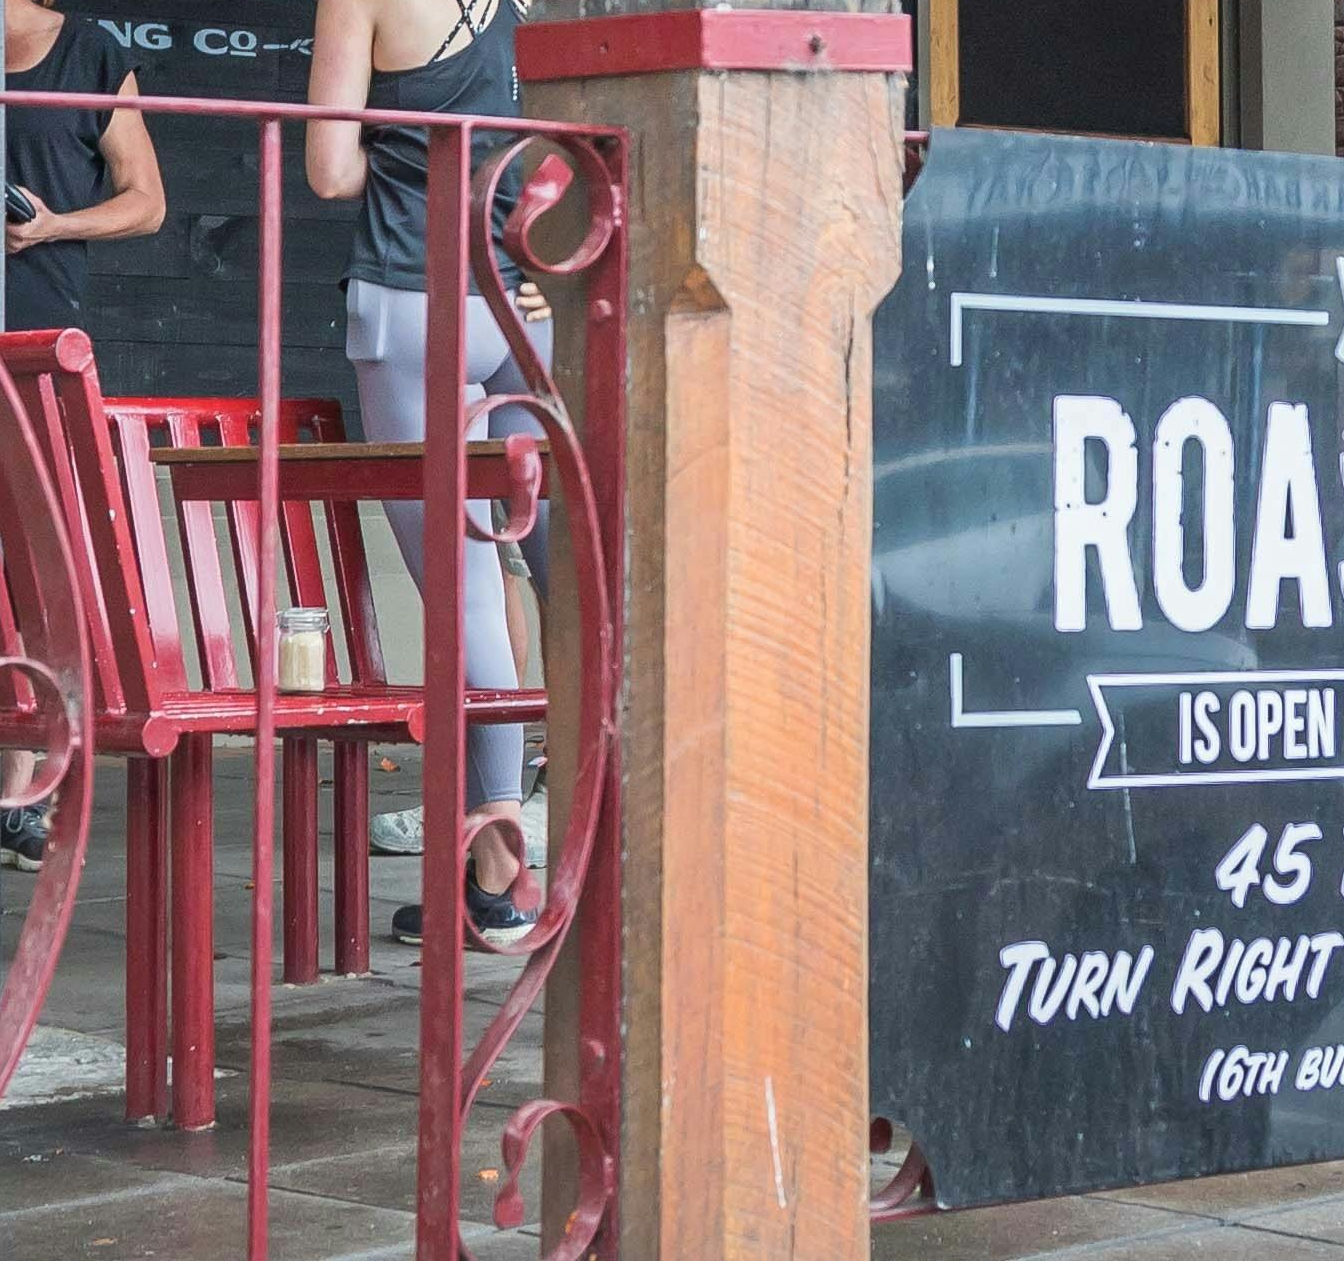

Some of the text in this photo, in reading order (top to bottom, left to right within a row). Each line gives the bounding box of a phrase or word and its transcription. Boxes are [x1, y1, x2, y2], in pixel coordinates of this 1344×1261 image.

[1179, 692, 1220, 766] IS
[1229, 686, 1335, 762] OPEN
[1215, 822, 1323, 909] 45
[994, 939, 1155, 1032] TURN
[1170, 924, 1344, 1015] RIGHT
[1198, 1030, 1289, 1102] (6TH
